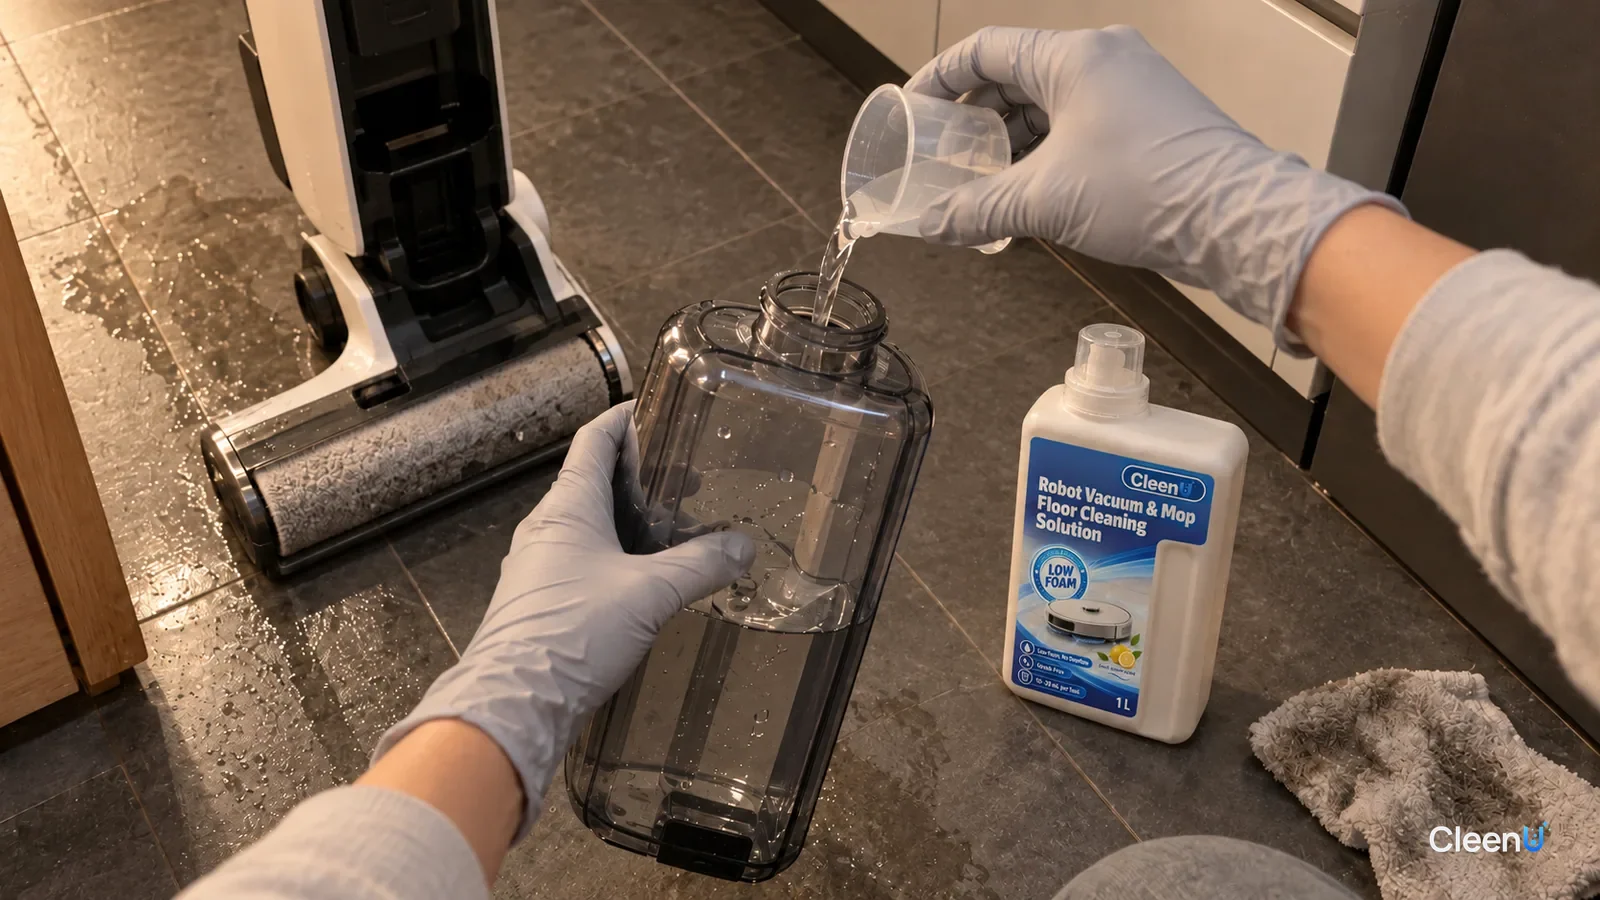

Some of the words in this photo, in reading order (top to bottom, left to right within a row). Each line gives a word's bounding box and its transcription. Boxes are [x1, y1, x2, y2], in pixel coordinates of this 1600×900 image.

[1037, 495, 1078, 518] Floor
[1080, 505, 1148, 537] Cleaning
[1038, 476, 1082, 500] Robot
[1085, 486, 1144, 514] Vacuum
[1146, 501, 1158, 517] &
[1160, 503, 1196, 528] Mop
[1035, 512, 1102, 543] Solution
[1045, 576, 1077, 589] FOAM
[1048, 564, 1074, 577] LOW
